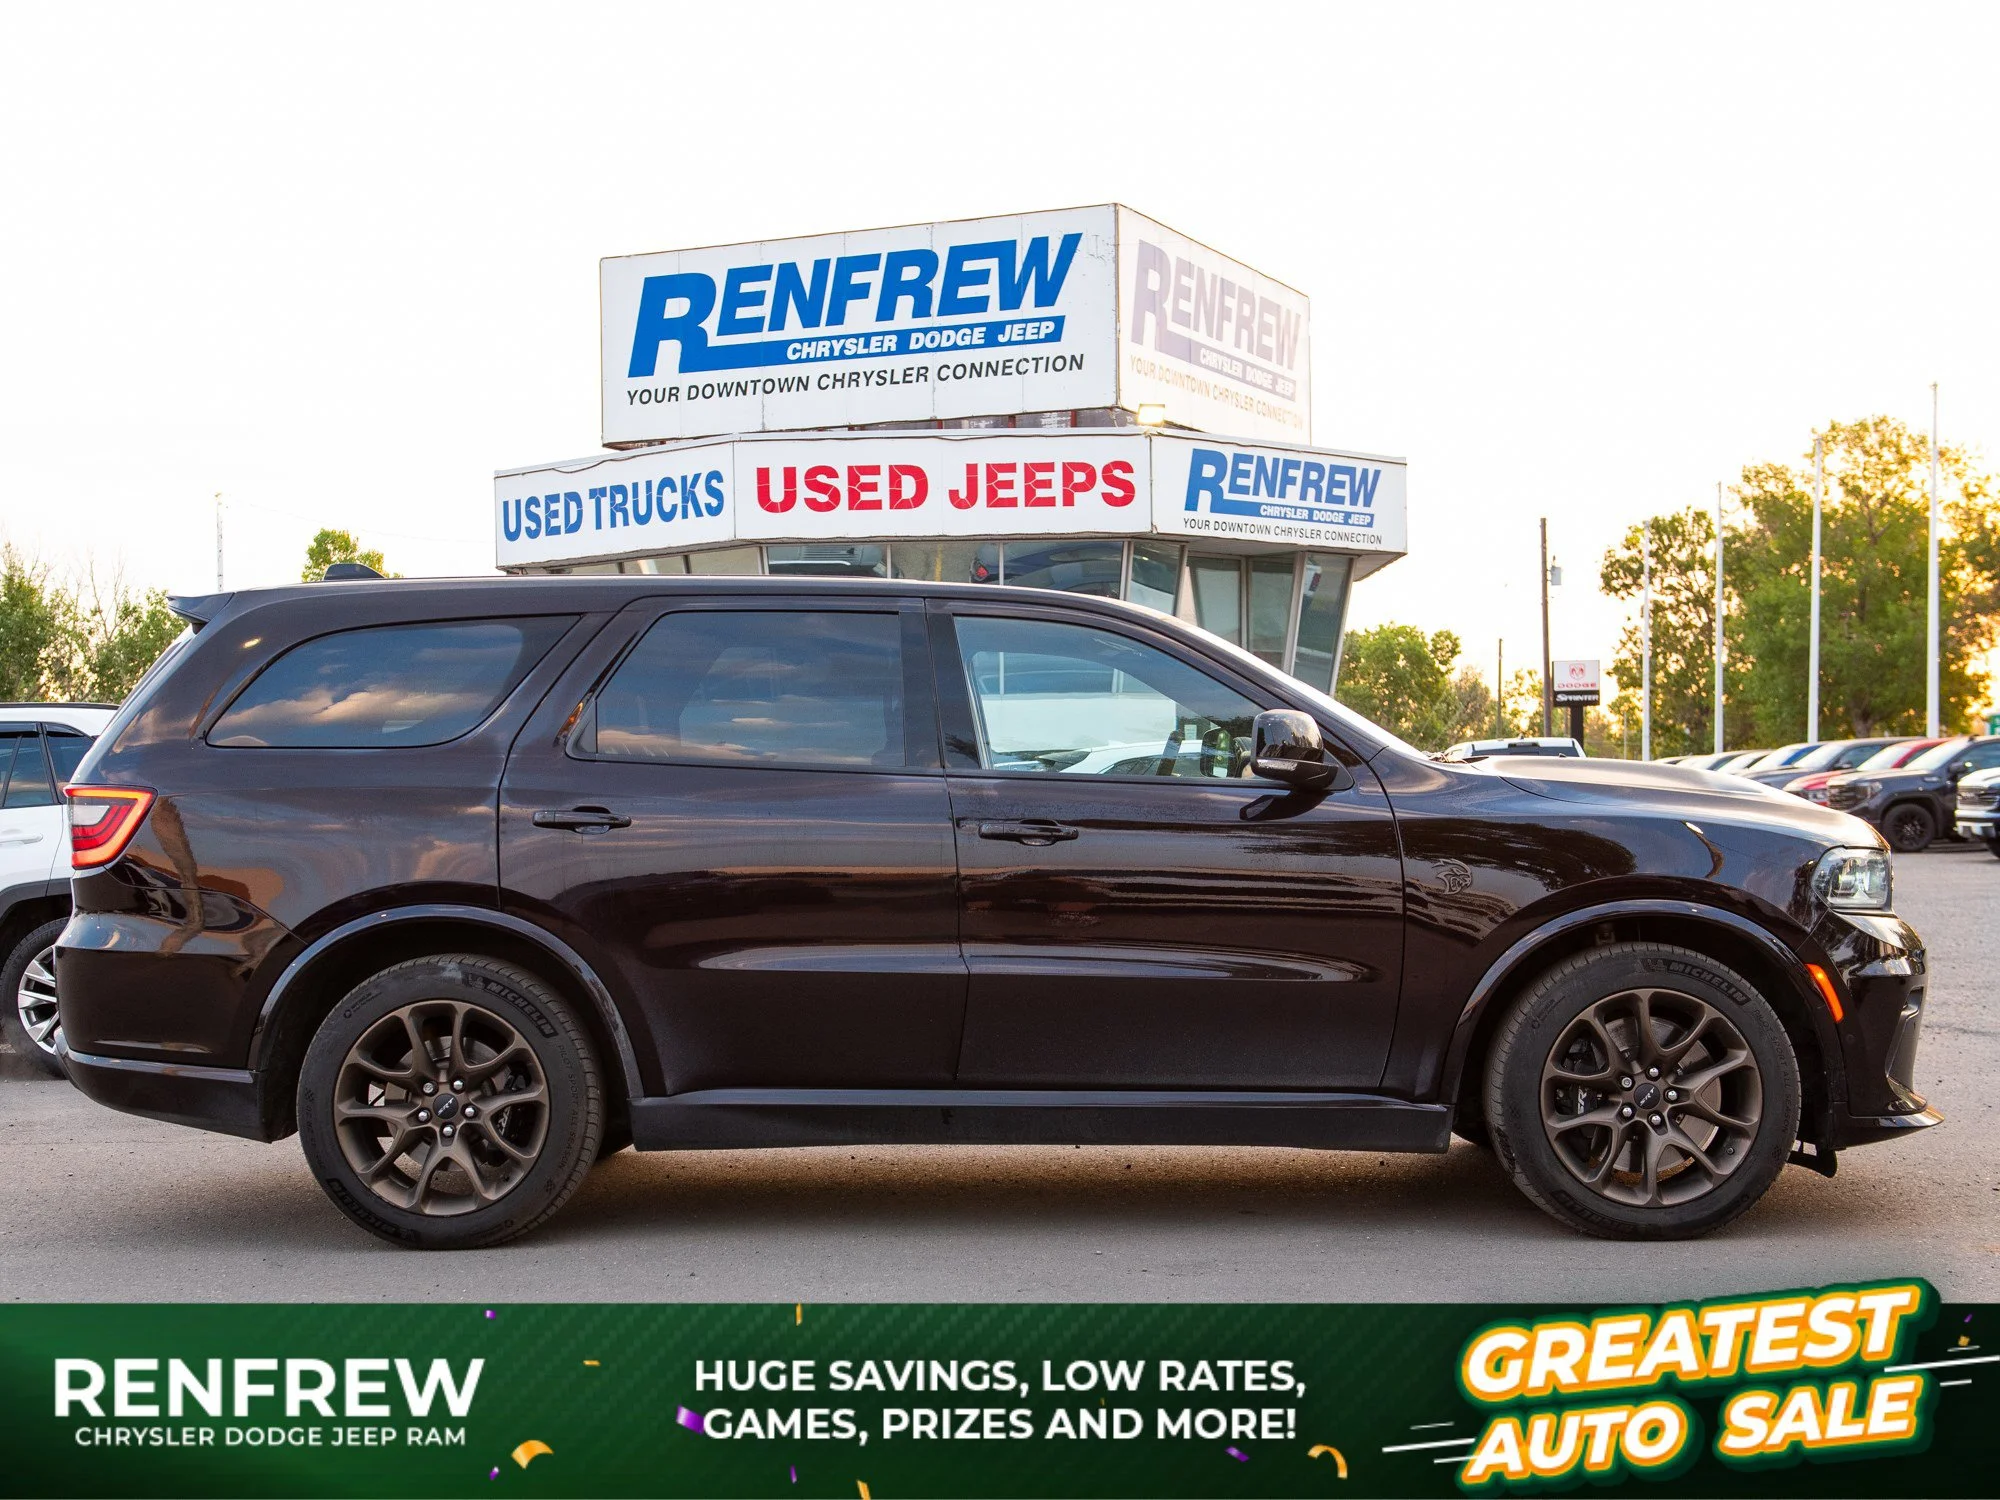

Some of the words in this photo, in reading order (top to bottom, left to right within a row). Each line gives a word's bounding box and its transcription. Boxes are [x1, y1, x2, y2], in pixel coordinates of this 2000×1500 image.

[627, 232, 1083, 378] RENFREW
[1131, 239, 1301, 372] RENFREW
[786, 334, 898, 361] CHRYSLER
[909, 326, 986, 350] DODGE
[997, 320, 1055, 344] JEEP
[627, 386, 680, 406] YOUR
[687, 375, 810, 401] DOWNTOWN
[817, 365, 929, 391] CHRYSLER
[937, 353, 1085, 382] CONNECTION
[1130, 355, 1155, 379] YOUR
[1158, 363, 1210, 398] DOWNTOWN
[1213, 384, 1254, 416] CHRYSLER
[1200, 347, 1243, 379] CHRYSLER
[1275, 377, 1295, 395] JEEP
[502, 491, 583, 542] USED
[588, 469, 725, 530] TRUCKS
[756, 464, 929, 514] USED
[948, 460, 1136, 510] JEEPS
[1184, 447, 1382, 512] RENFREW
[1183, 518, 1210, 531] YOUR
[1214, 520, 1271, 536] DOWNTOWN
[1274, 527, 1322, 540] CHRYSLER
[1325, 530, 1382, 545] CONNECTION
[1260, 504, 1309, 520] CHRYSLER
[1313, 510, 1345, 524] DODGE
[1348, 513, 1372, 526] JEEP
[485, 980, 556, 1036] MICHELIN
[1668, 961, 1748, 1003] MICHELIN
